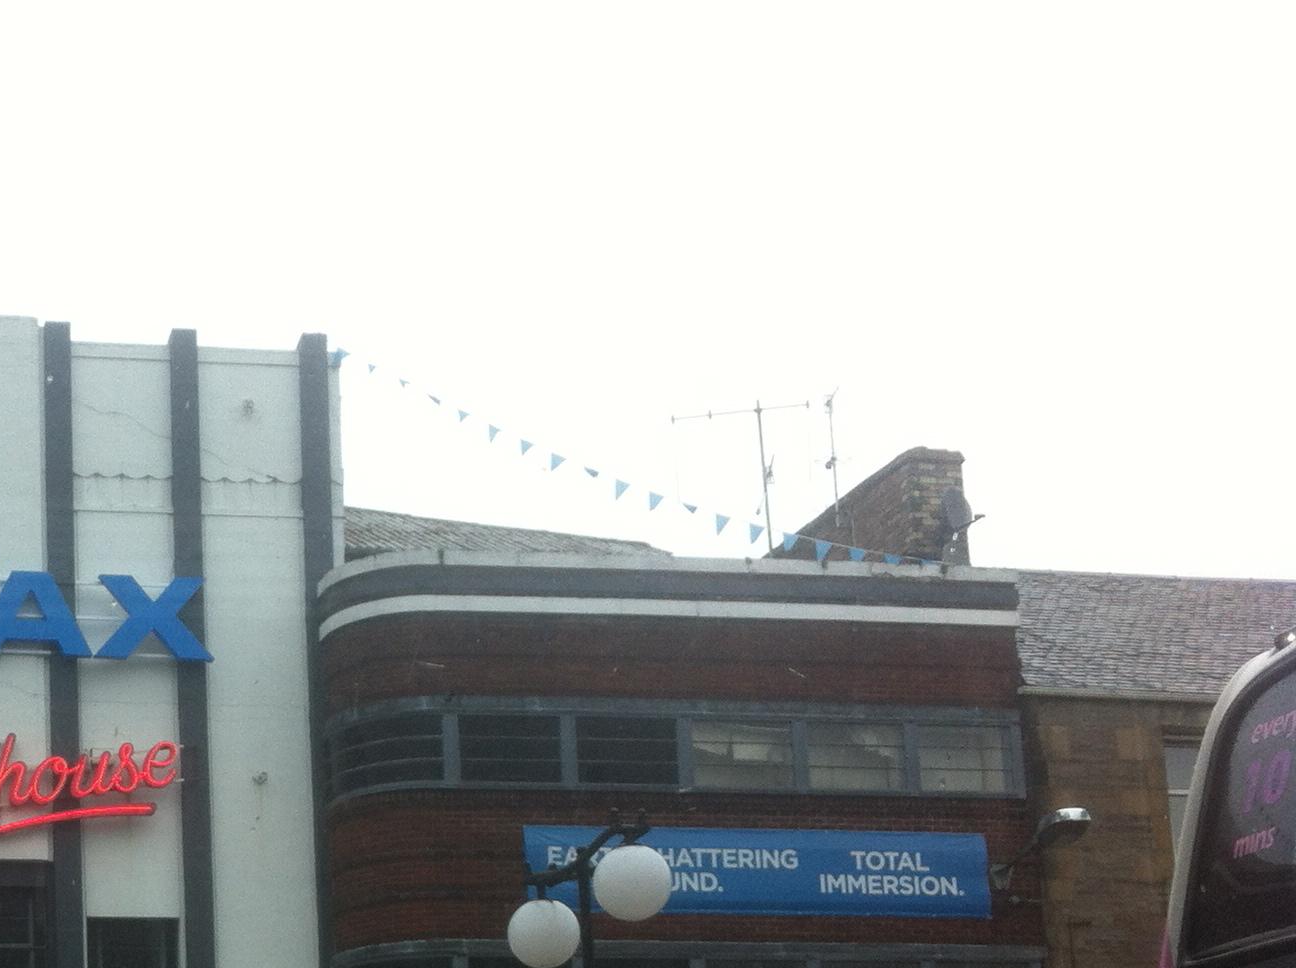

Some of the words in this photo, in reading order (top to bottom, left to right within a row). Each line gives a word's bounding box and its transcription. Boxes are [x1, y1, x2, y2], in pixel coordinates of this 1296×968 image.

[1241, 751, 1292, 816] 10
[1233, 827, 1277, 859] mins
[850, 850, 930, 872] TOTAL
[819, 874, 965, 897] IMMERSION.
